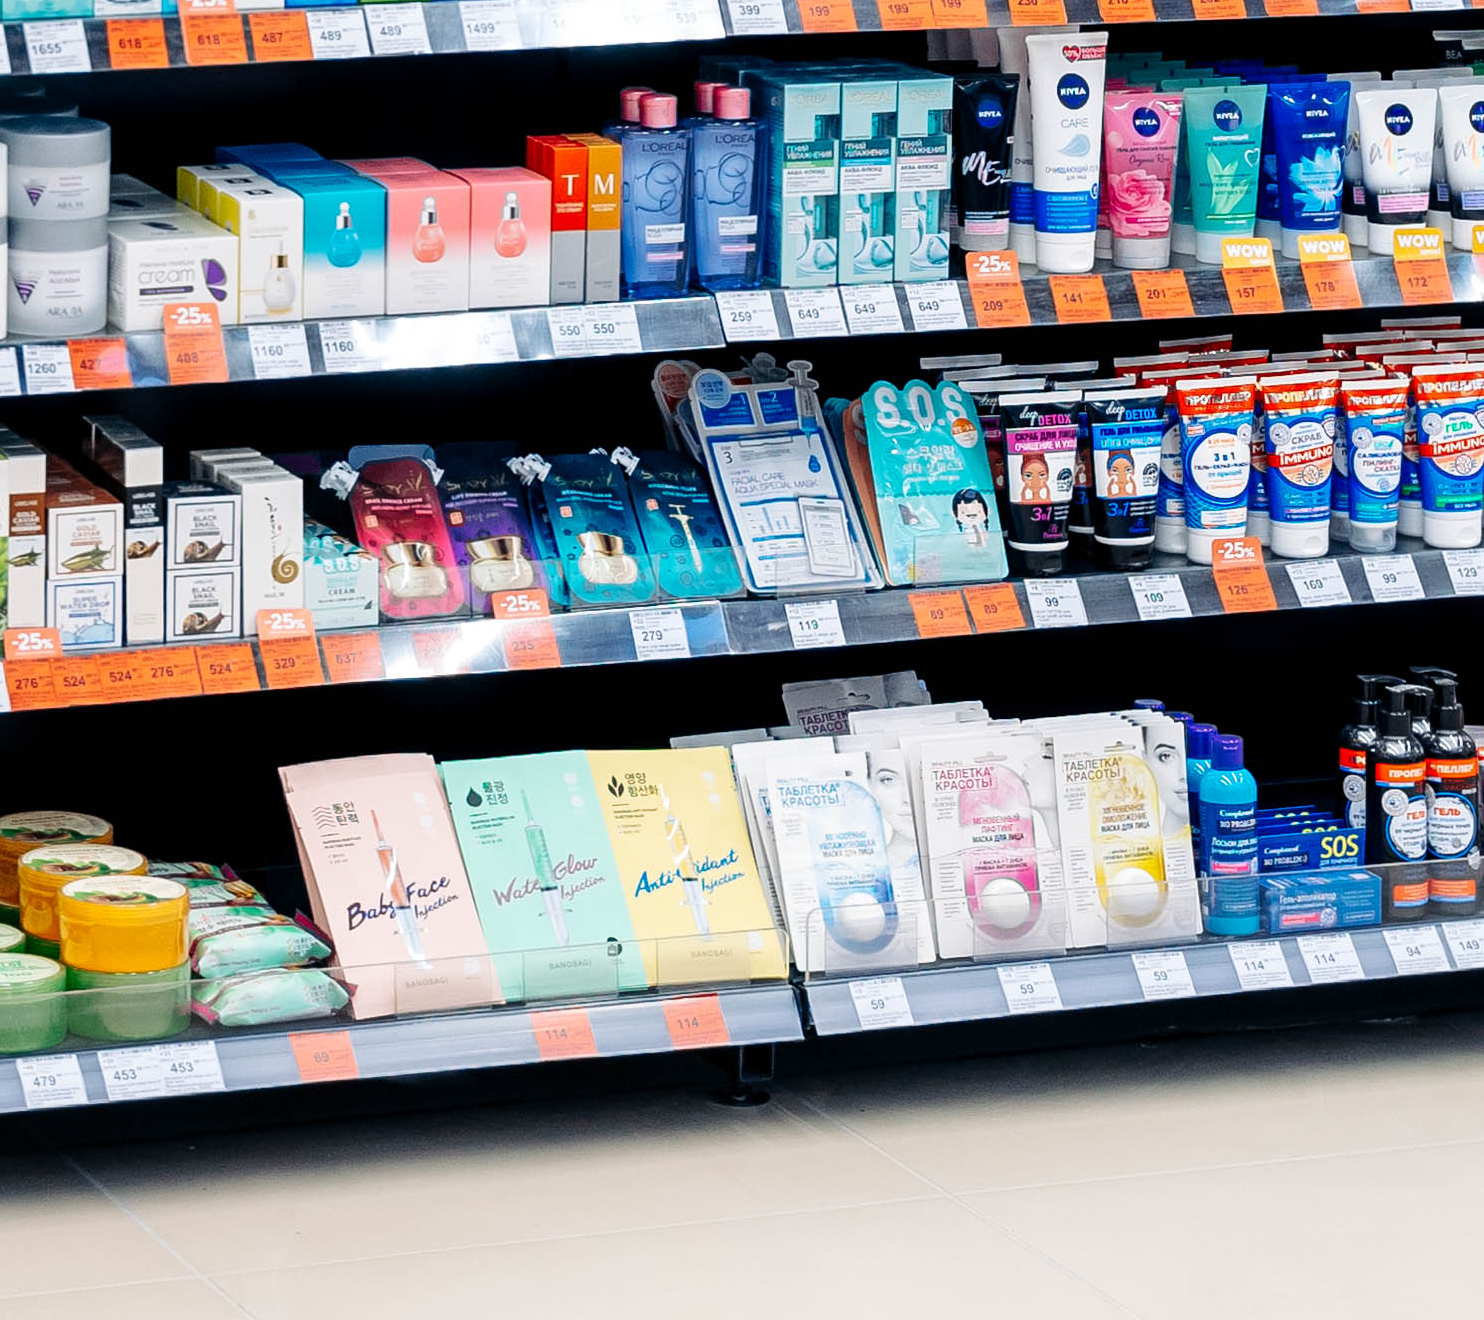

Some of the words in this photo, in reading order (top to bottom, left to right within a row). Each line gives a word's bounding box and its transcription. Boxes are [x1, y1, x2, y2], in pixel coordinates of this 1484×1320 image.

[1060, 87, 1086, 96] NIVEA
[979, 111, 1002, 119] NIVEA
[561, 175, 580, 196] T
[594, 173, 614, 195] M
[1226, 244, 1268, 258] WOW
[1302, 240, 1345, 254] WOW
[974, 255, 1010, 273] -25%
[138, 267, 196, 285] cream
[1020, 406, 1038, 426] deep
[1039, 414, 1071, 426] DETOX
[1106, 402, 1125, 421] deep
[1126, 409, 1157, 420] DETOX
[1445, 421, 1474, 434] ГЕЛЬ
[1291, 433, 1323, 445] СКРАБ
[731, 473, 759, 485] FACIAL
[760, 472, 785, 481] CARE
[1218, 542, 1254, 560] -25%
[1218, 543, 1255, 560] -25%
[935, 777, 993, 791] КРАСОТЫ
[1065, 768, 1120, 783] КРАСОТЫ
[782, 794, 839, 808] КРАСОТЫ
[1321, 833, 1360, 860] SOS
[553, 854, 598, 882] Glow
[404, 873, 452, 898] Face
[560, 875, 606, 901] Injection
[1020, 983, 1034, 995] 59
